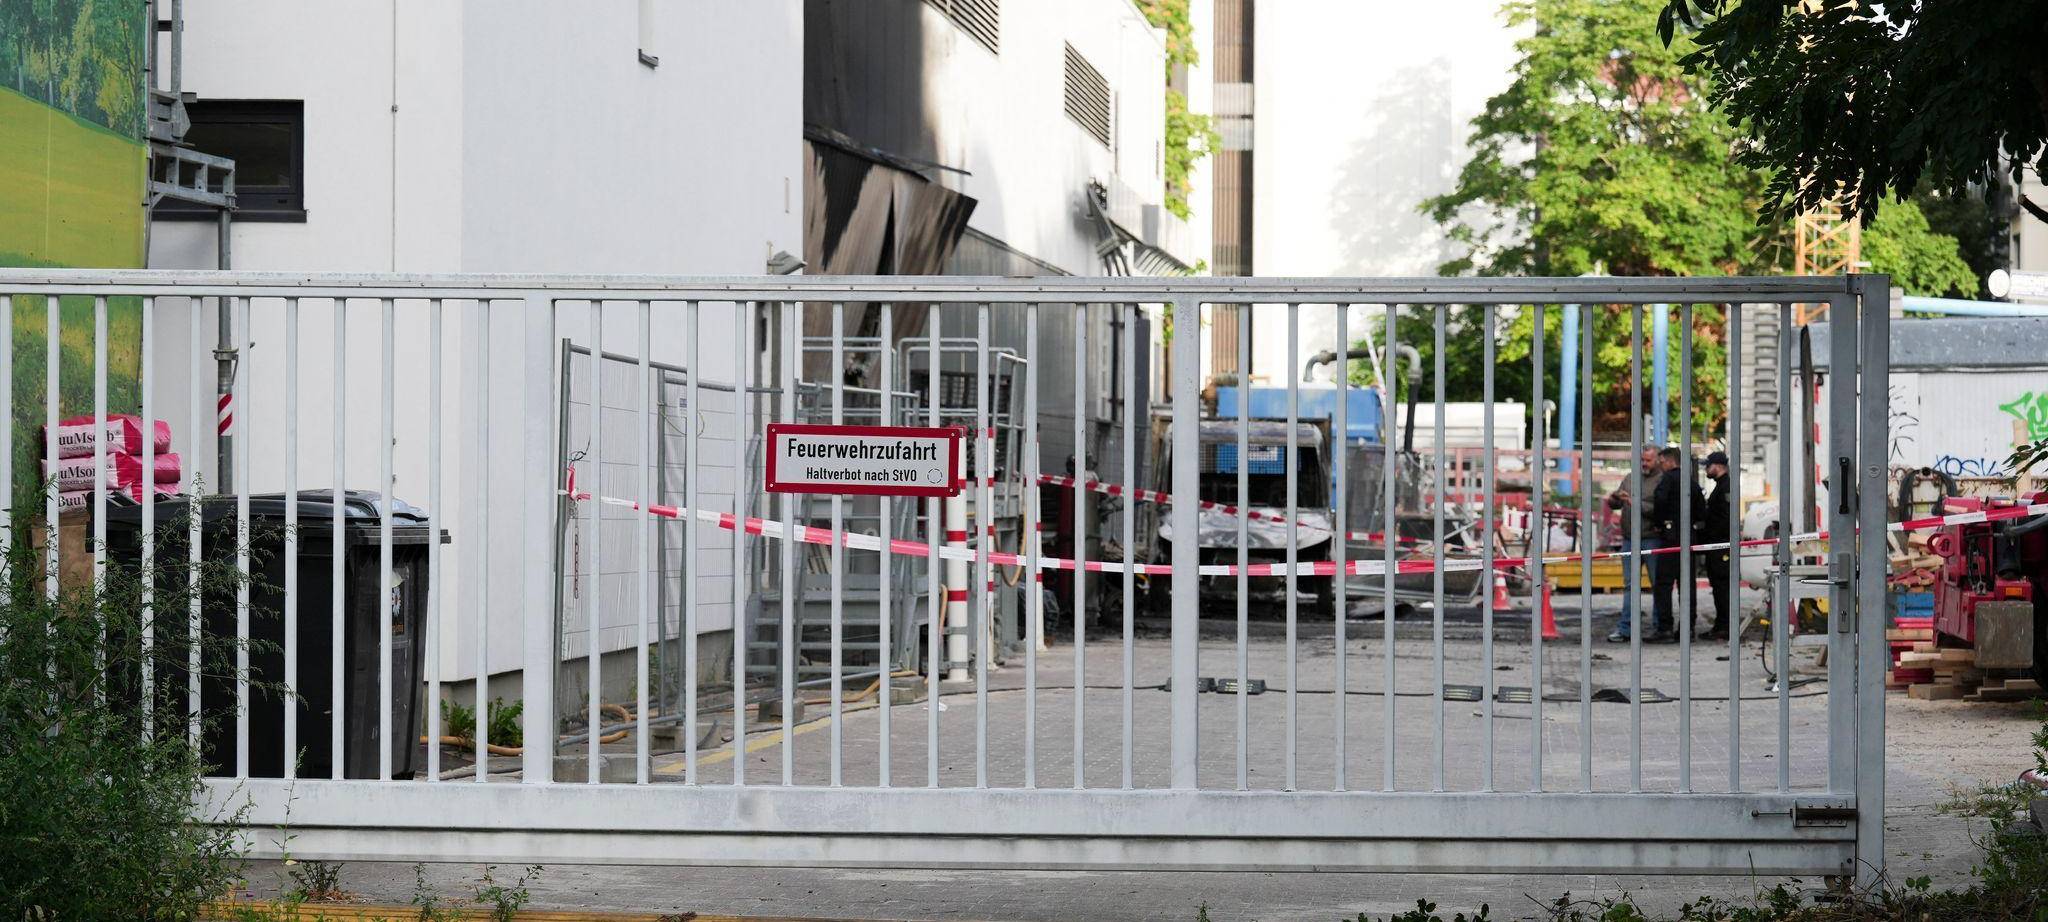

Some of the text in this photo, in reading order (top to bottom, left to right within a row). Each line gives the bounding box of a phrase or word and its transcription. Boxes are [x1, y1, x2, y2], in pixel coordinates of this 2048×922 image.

[788, 438, 937, 460] Feuerwehrzufahrt
[806, 467, 917, 482] Haltverbot nach StVO
